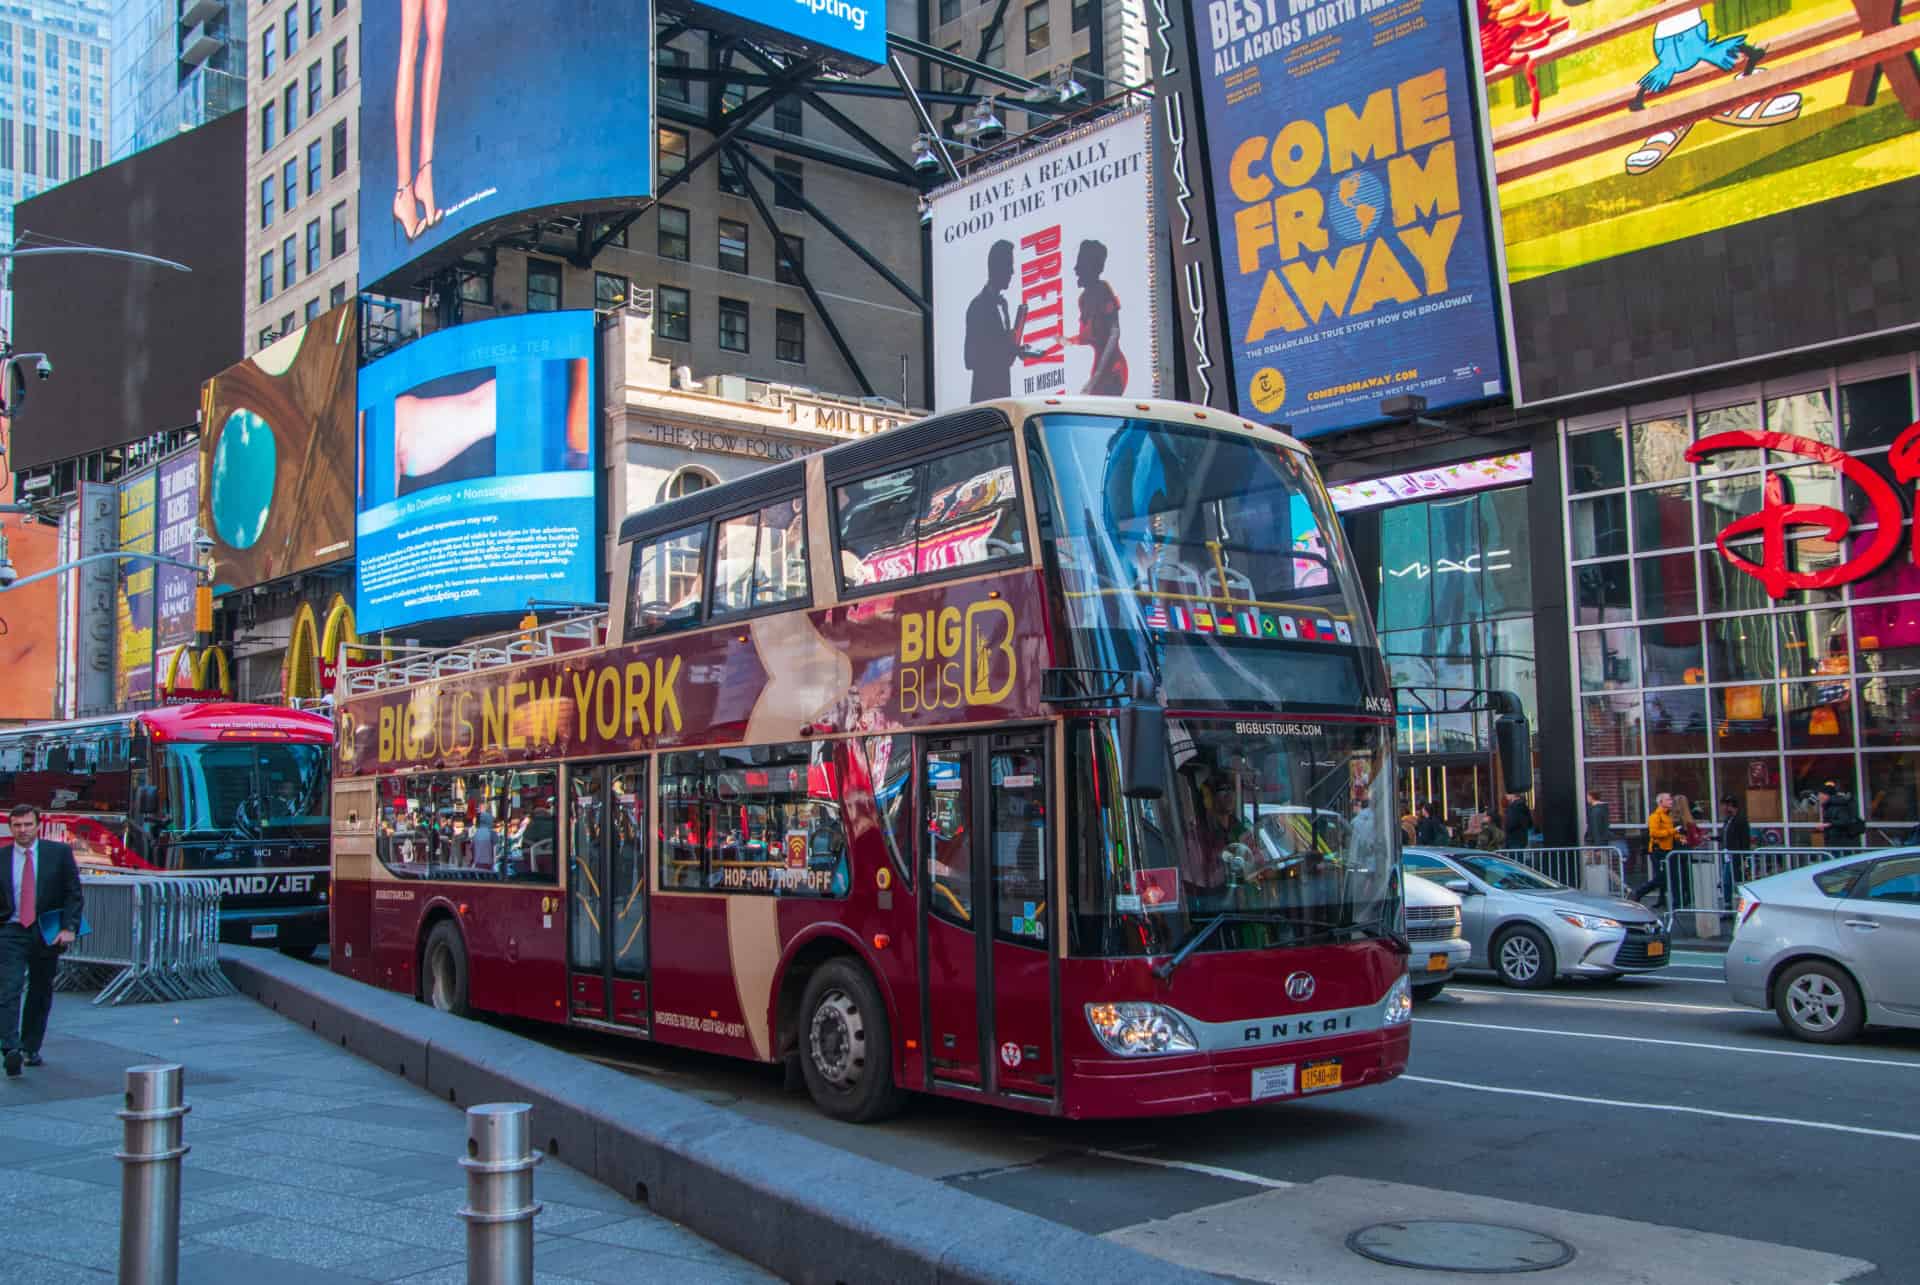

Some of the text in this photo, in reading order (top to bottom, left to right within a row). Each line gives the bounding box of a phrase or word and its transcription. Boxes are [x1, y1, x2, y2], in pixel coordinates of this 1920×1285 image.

[1208, 0, 1277, 50] BEST
[1215, 46, 1240, 76] ALL
[1244, 17, 1302, 64] ACROSS
[1306, 0, 1356, 36] NORTH
[1229, 67, 1451, 203] COME
[944, 151, 1143, 244] GOOD TIME TONIGHT
[969, 139, 1111, 211] HAVE A REALLY
[1234, 140, 1461, 275] FROM
[1020, 224, 1065, 367] PRETTY
[1245, 215, 1463, 343] AWAY
[1246, 294, 1473, 359] THE REMARKABLE TRUE STORY NOW ON BROADWAY
[1024, 368, 1065, 395] THE MUSICAL
[1307, 368, 1418, 401] COMEFROMAWAY.COM
[1421, 376, 1447, 388] STREET
[654, 424, 685, 444] THE
[691, 429, 738, 451] SHOW
[746, 439, 793, 460] FOLKS
[901, 606, 962, 663] BIG
[482, 675, 563, 752] NEW
[573, 654, 683, 743] YORK
[901, 661, 962, 713] BUS
[1235, 722, 1322, 736] BIGBUSTOURS.COM
[219, 874, 315, 894] AND/JET
[724, 868, 768, 887] HOP-ON
[1244, 1015, 1352, 1041] ANKAI
